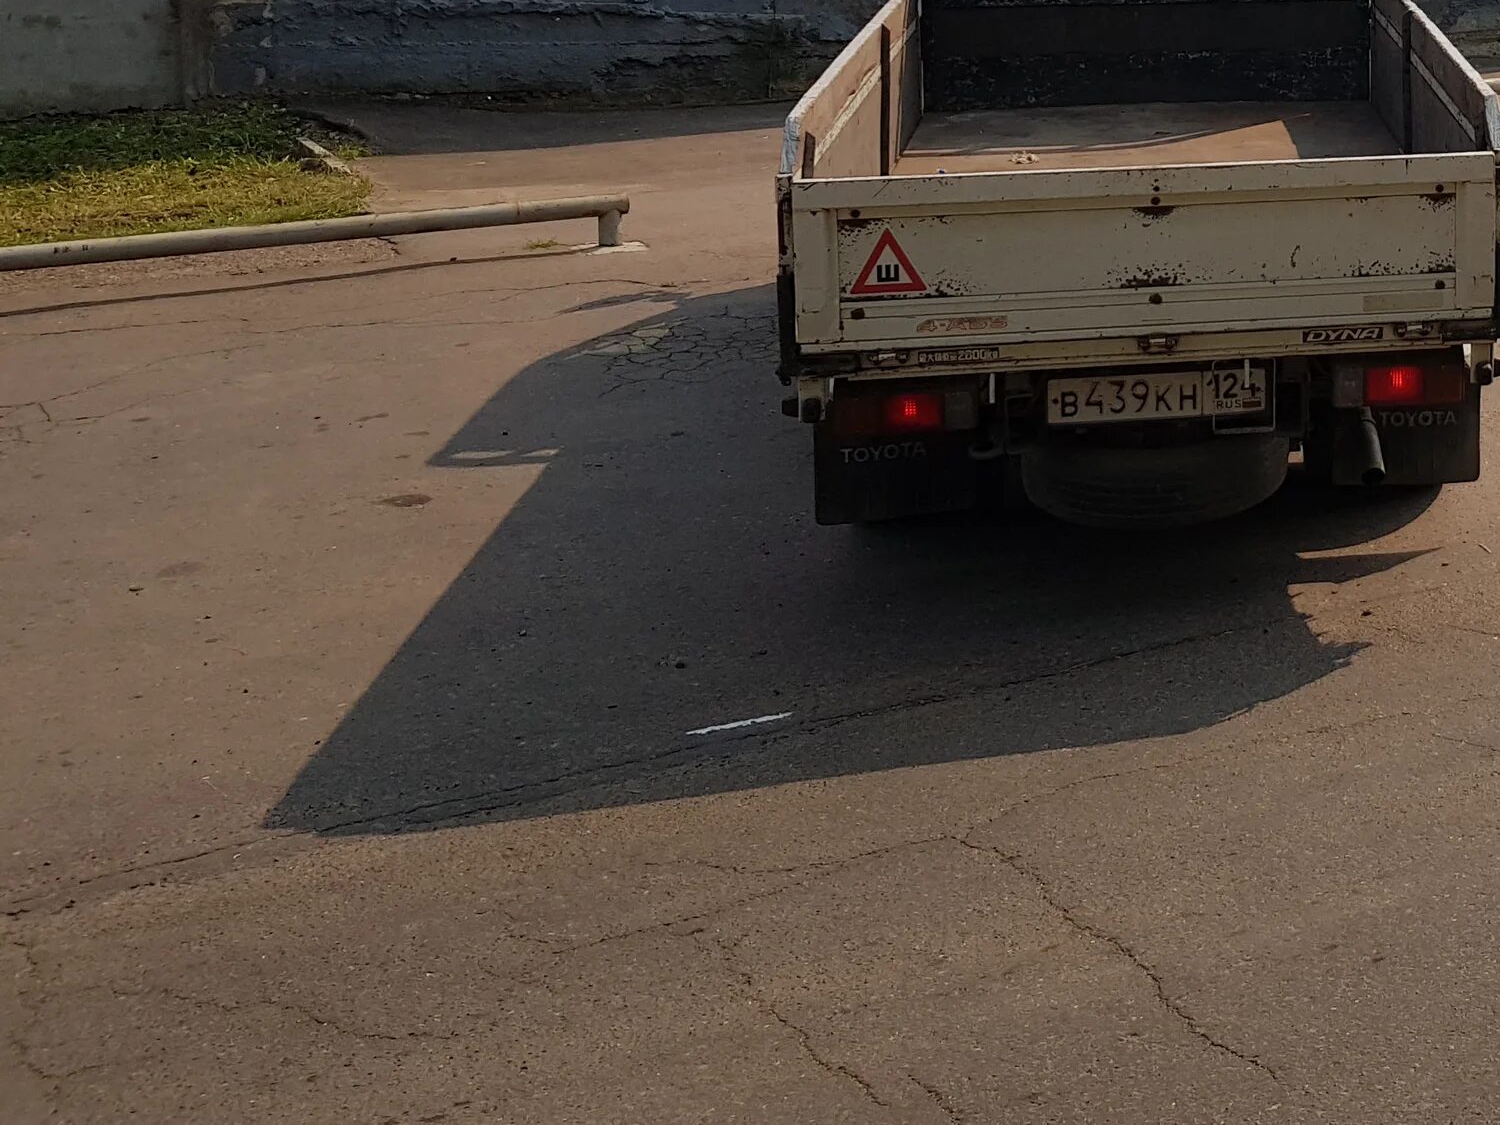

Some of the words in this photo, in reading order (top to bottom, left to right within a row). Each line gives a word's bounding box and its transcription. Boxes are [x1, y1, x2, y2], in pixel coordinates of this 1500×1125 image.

[876, 264, 900, 283] Ш
[1306, 327, 1380, 342] DYNA
[1215, 399, 1242, 410] RUS
[1378, 410, 1458, 427] TOYOTA
[840, 441, 928, 464] TOYOTA
